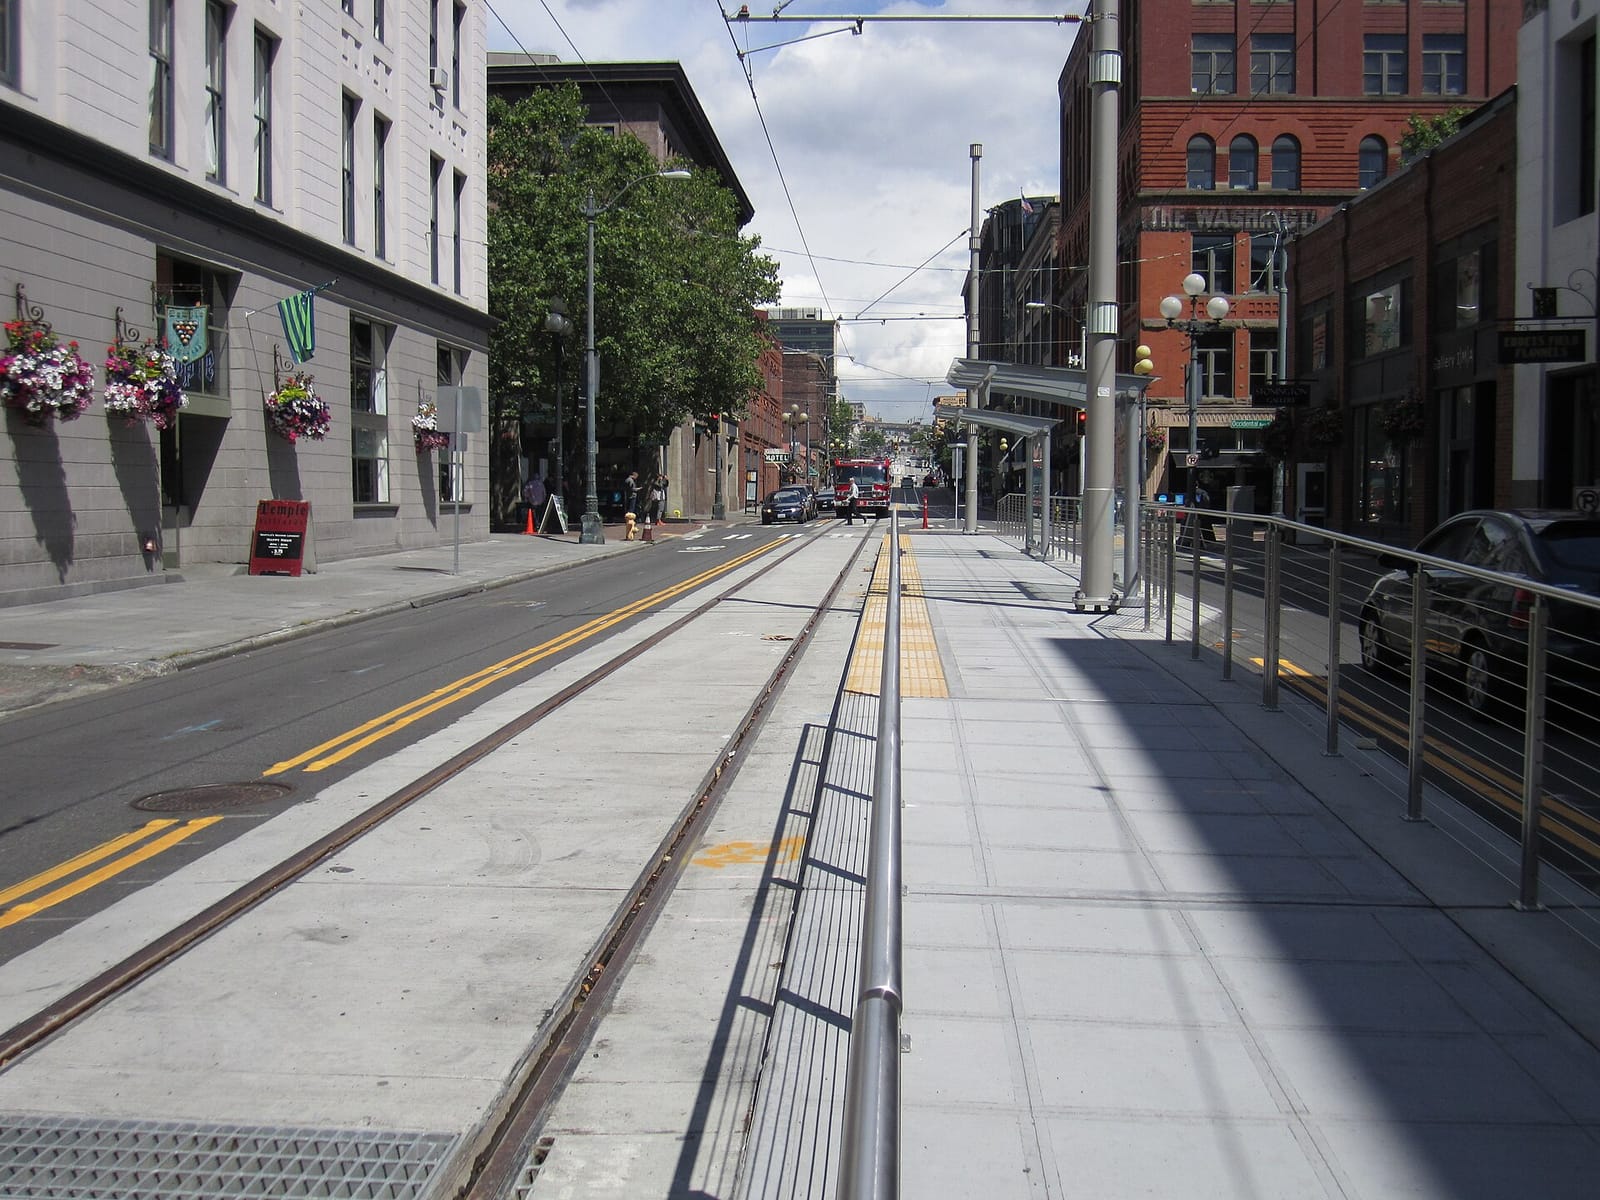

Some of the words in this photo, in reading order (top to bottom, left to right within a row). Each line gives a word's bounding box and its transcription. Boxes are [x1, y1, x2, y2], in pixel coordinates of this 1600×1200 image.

[1152, 207, 1185, 229] THE
[1231, 420, 1259, 428] Occidental
[258, 502, 306, 517] Temple
